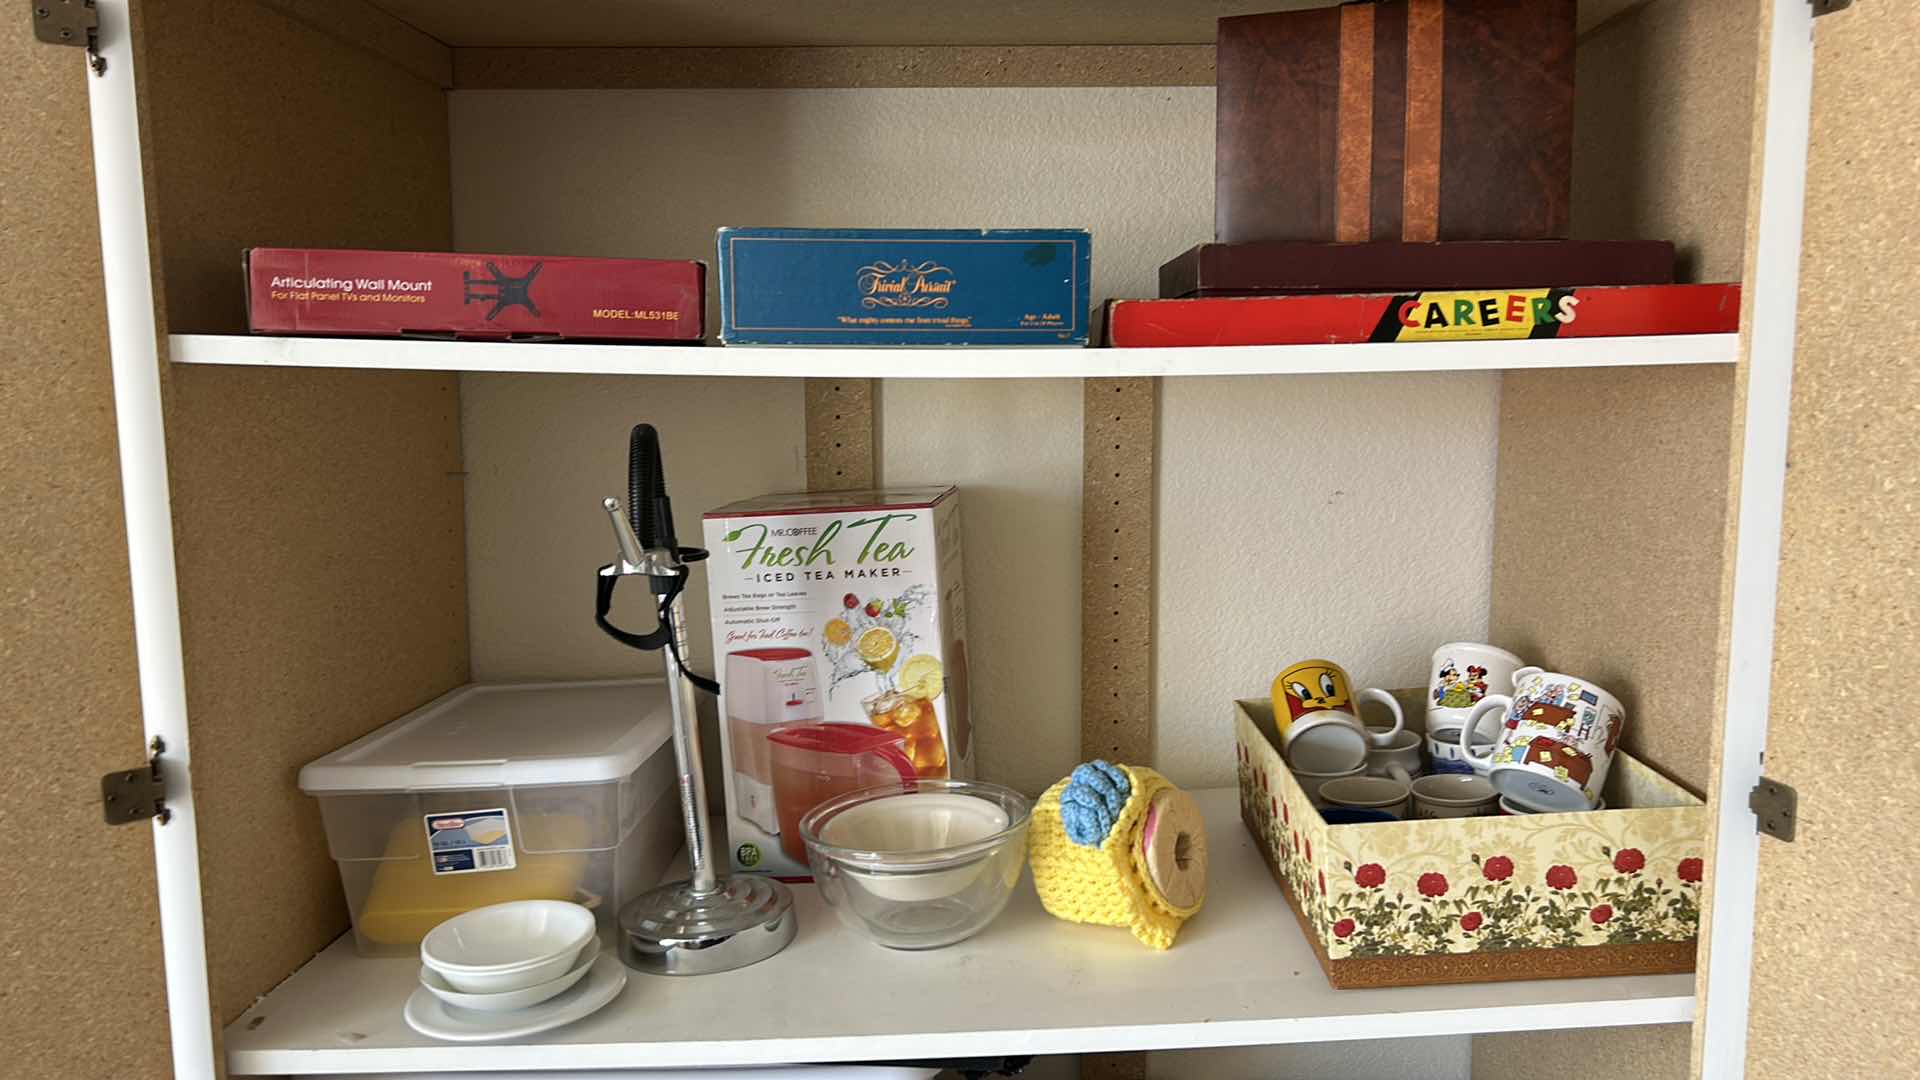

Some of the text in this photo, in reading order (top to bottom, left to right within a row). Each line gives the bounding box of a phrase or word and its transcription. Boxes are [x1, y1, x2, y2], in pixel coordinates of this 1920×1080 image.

[271, 276, 432, 291] Articulating Wall Mount
[271, 291, 288, 299] For
[290, 291, 310, 300] Flat
[311, 292, 339, 300] Panel
[359, 292, 381, 301] and
[382, 293, 425, 303] Monitors
[1397, 295, 1580, 328] CAREERS
[724, 520, 842, 569] Fresh
[847, 513, 917, 564] Tea
[756, 567, 901, 583] ICED TEA MAKER
